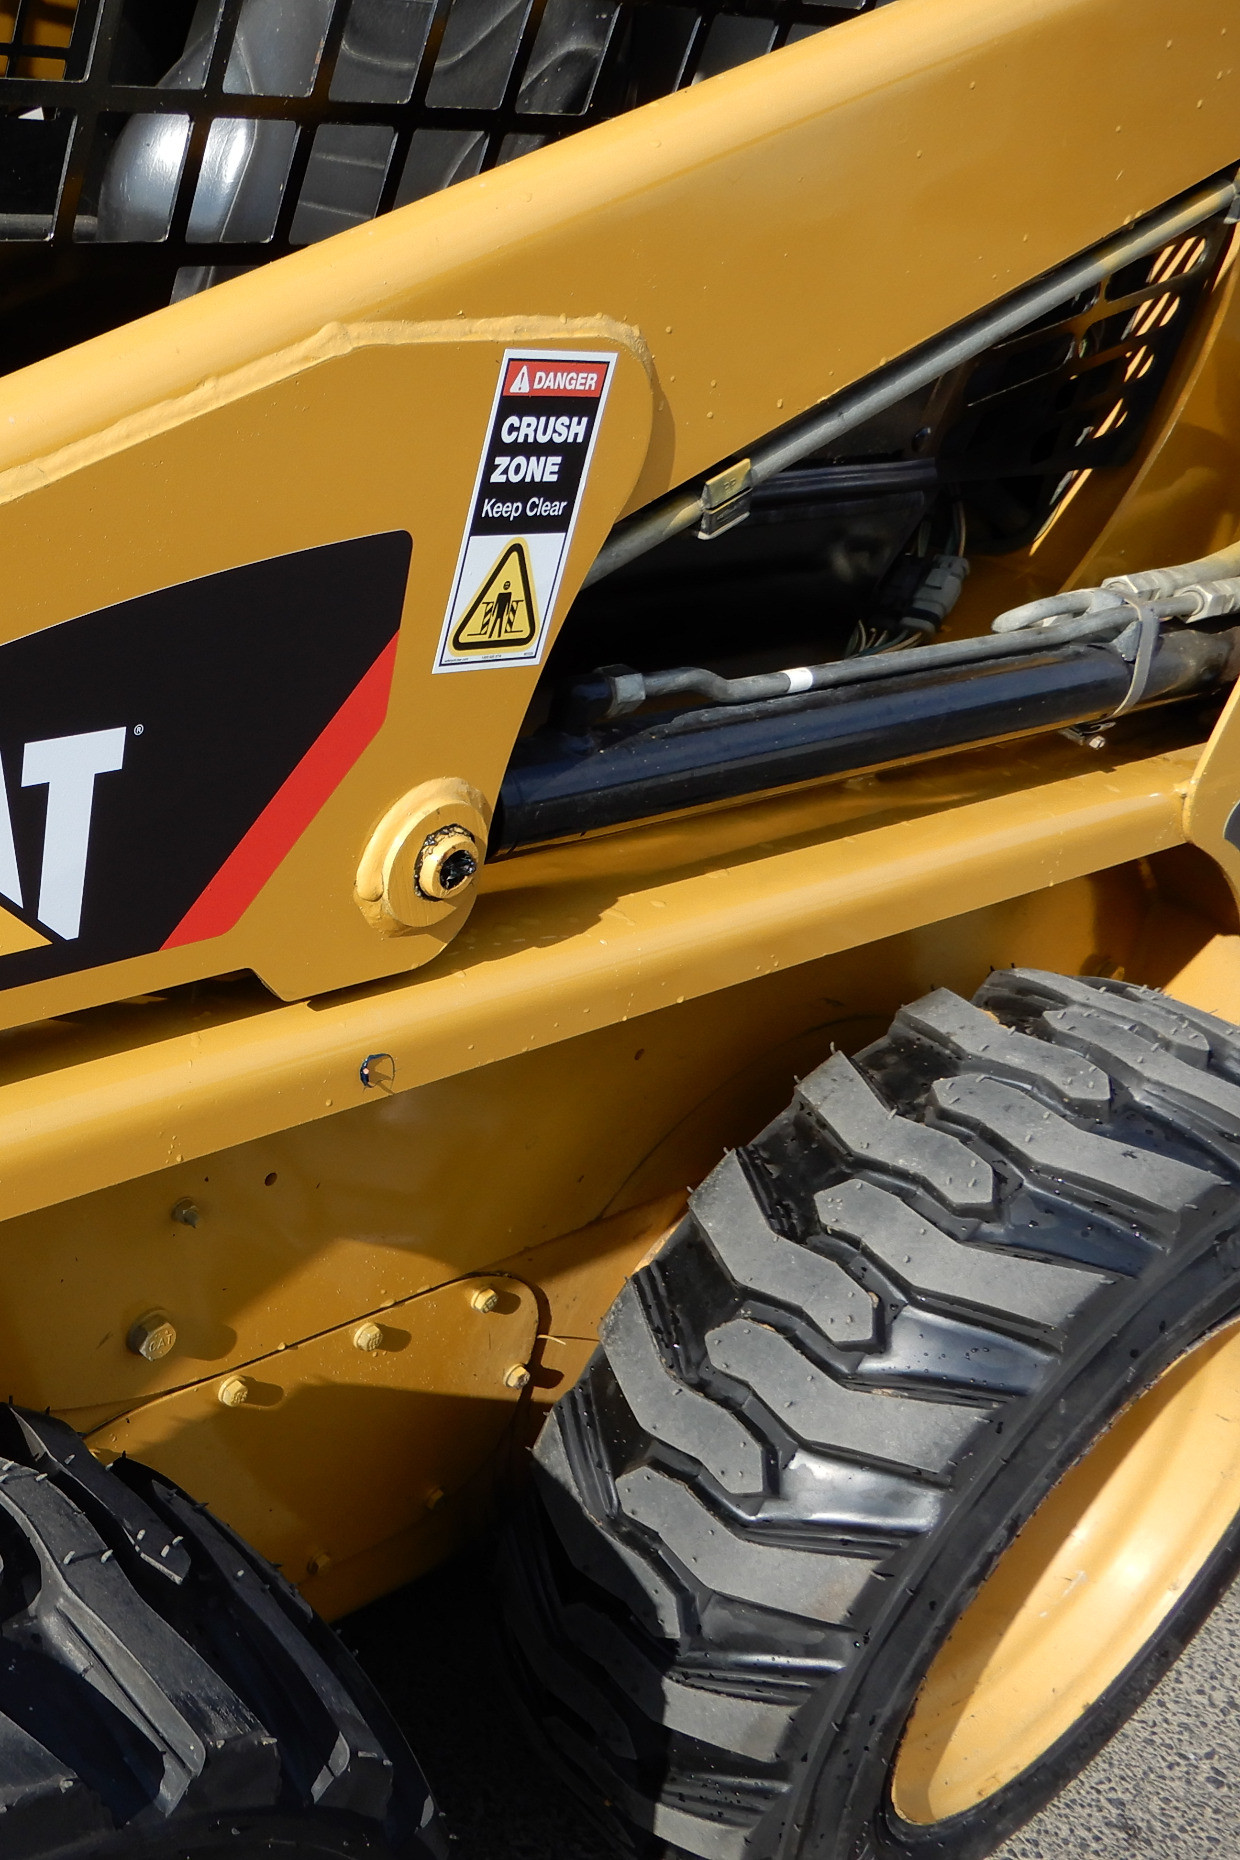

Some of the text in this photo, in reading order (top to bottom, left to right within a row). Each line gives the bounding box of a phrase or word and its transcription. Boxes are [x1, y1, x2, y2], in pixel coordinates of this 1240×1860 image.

[533, 370, 598, 391] DANGER
[500, 415, 589, 444] CRUSH
[489, 456, 563, 483] ZONE
[481, 496, 567, 521] Keep Clear
